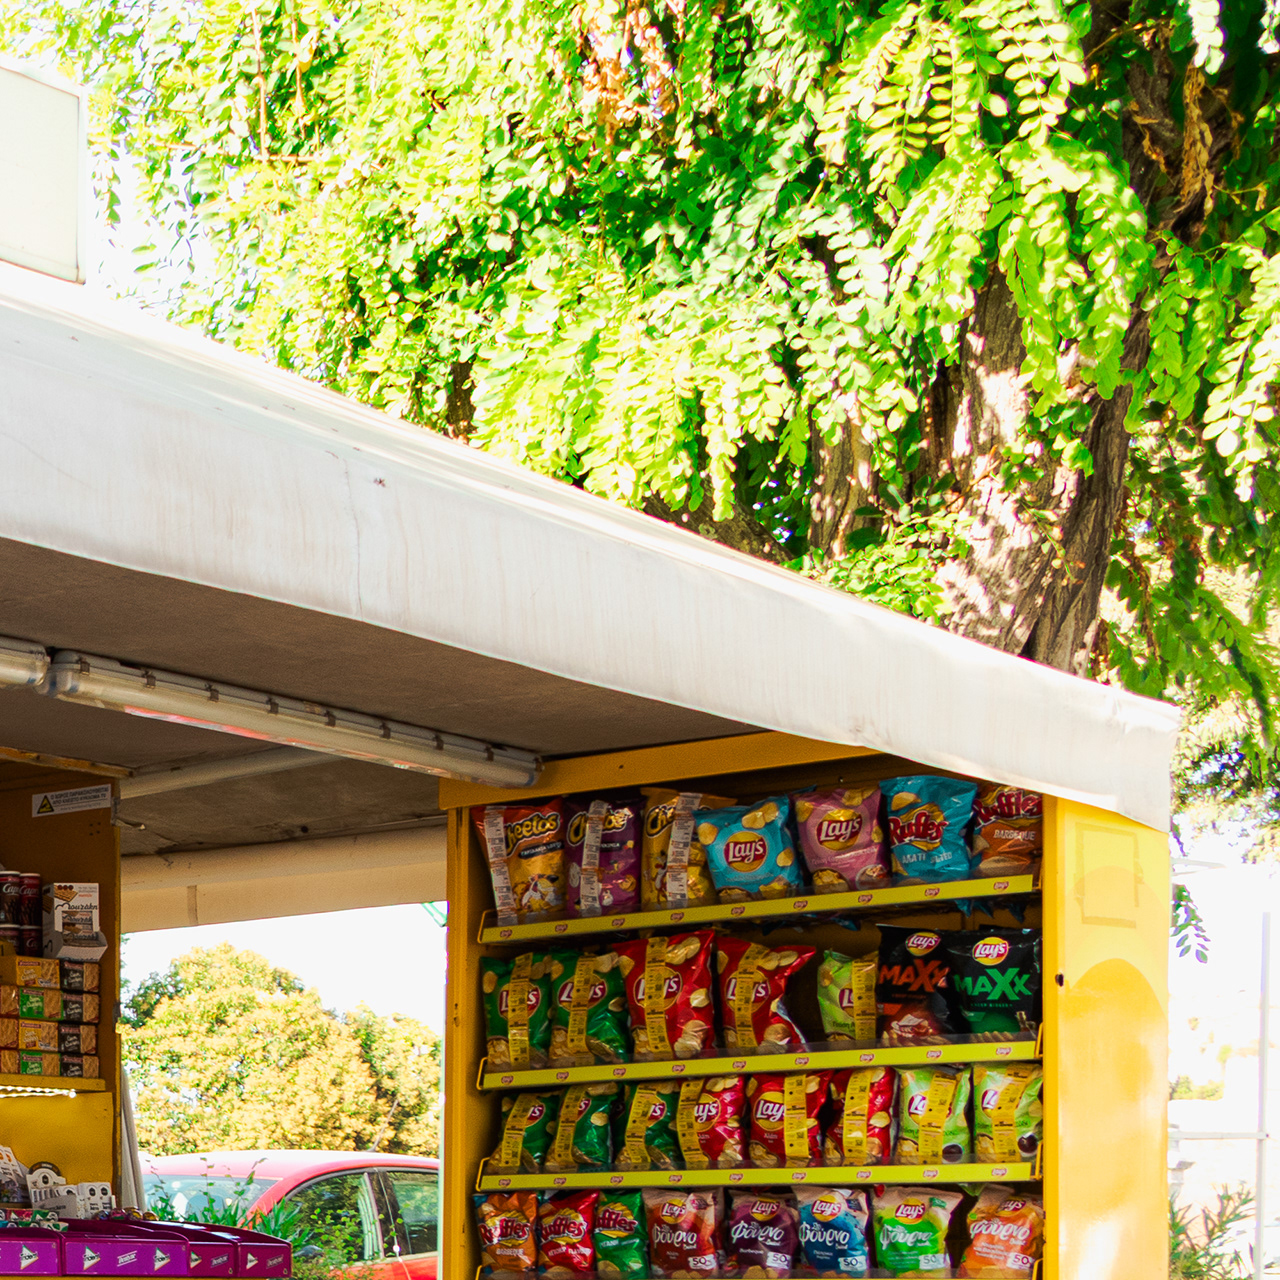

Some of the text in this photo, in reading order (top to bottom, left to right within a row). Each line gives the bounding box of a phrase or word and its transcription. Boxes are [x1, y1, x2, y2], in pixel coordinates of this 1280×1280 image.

[820, 816, 863, 842] Lay's
[724, 838, 766, 864] Lay's
[906, 933, 940, 950] Lay's
[973, 941, 1009, 961] Lay's
[878, 959, 950, 992] MAXX
[953, 967, 1033, 1001] MAXX
[813, 1199, 842, 1217] Lay's
